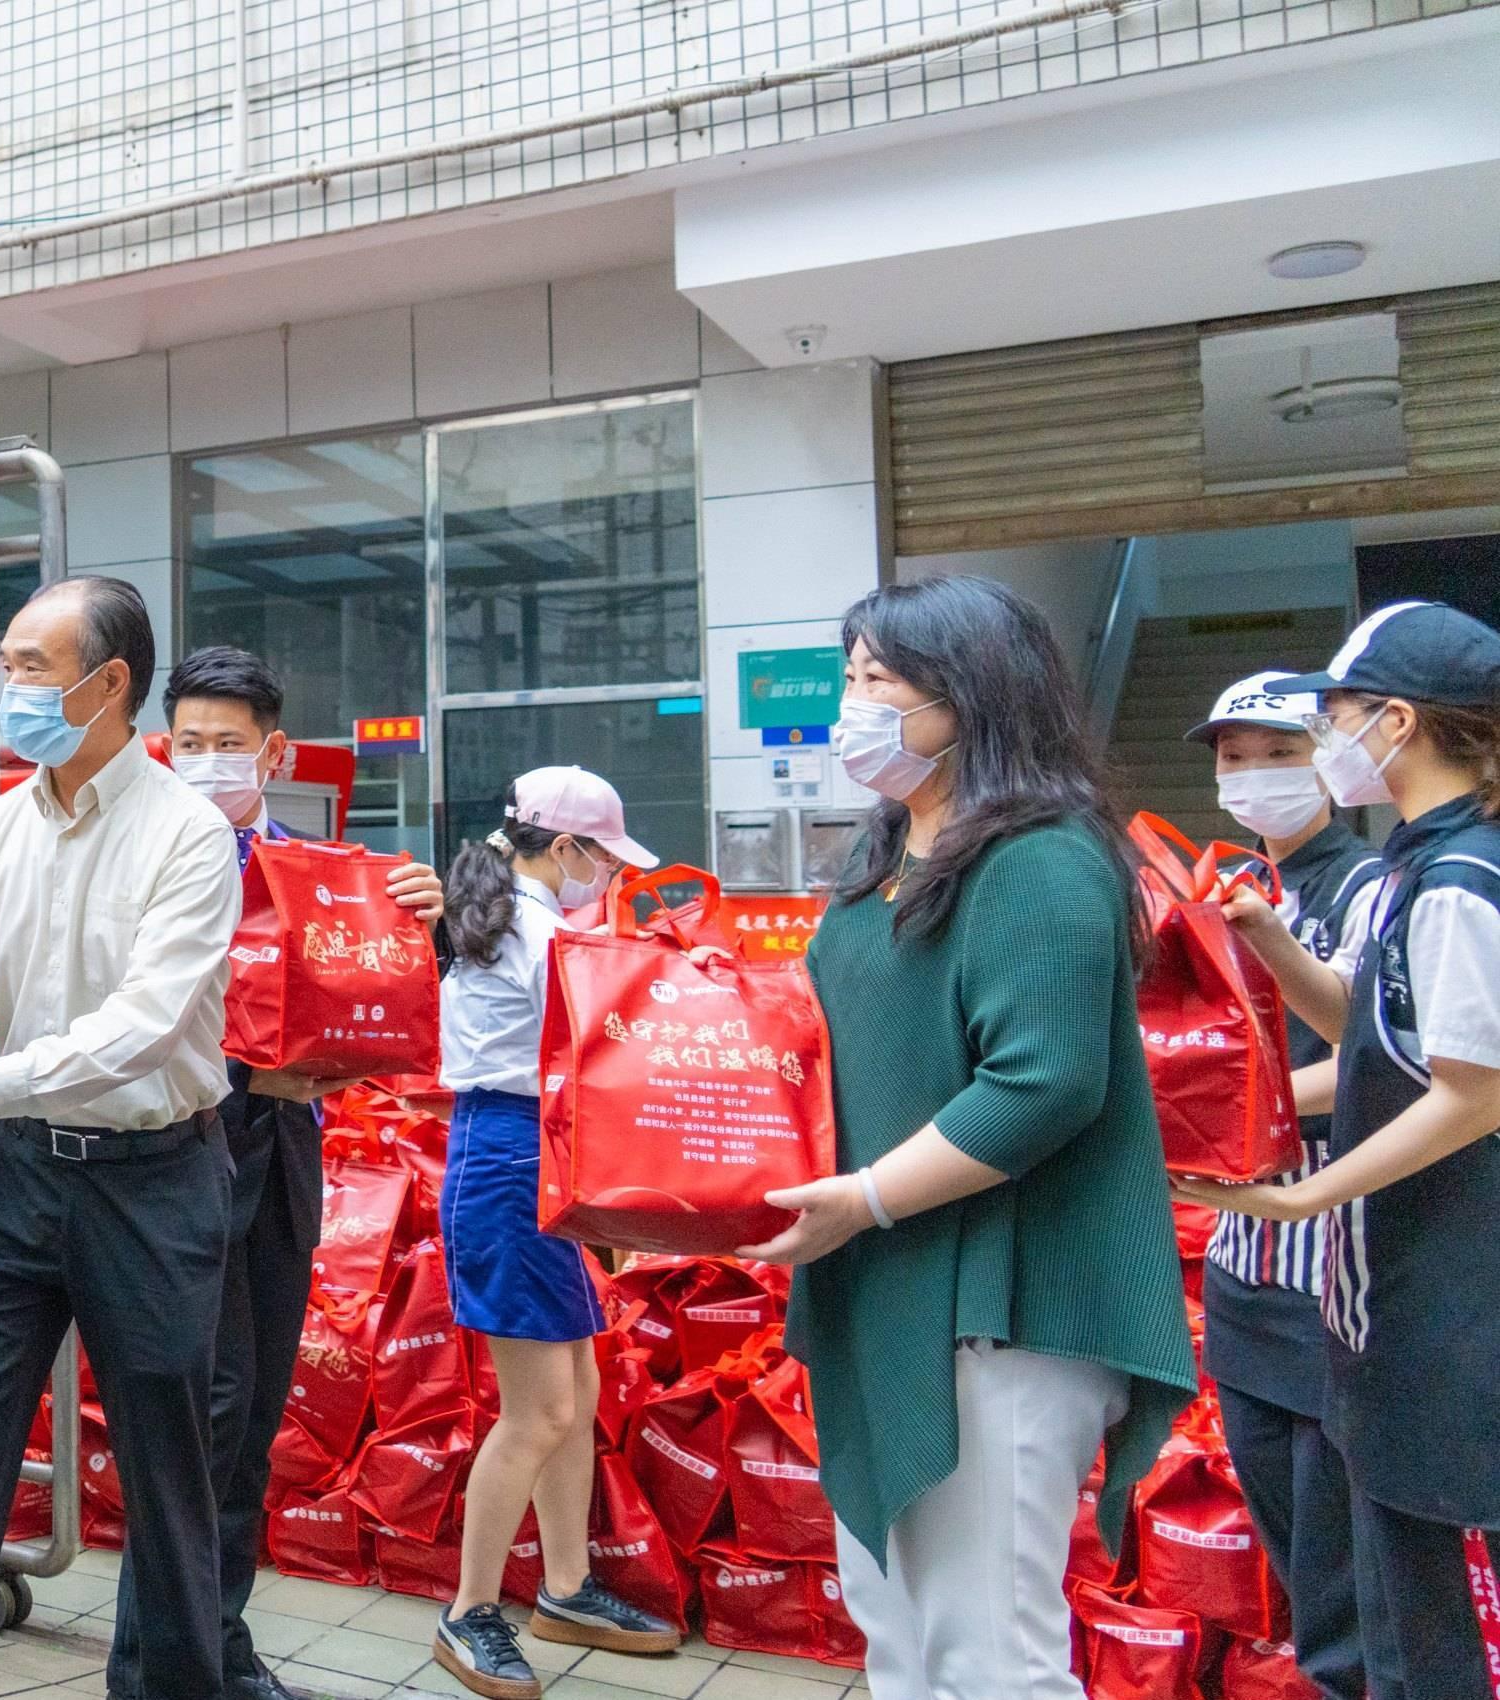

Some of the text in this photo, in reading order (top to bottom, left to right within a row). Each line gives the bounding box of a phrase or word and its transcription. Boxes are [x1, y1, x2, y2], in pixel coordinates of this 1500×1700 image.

[303, 920, 409, 973] 感恩有你
[604, 1011, 750, 1045] 您守护我们
[646, 1044, 805, 1087] 我们温暖您
